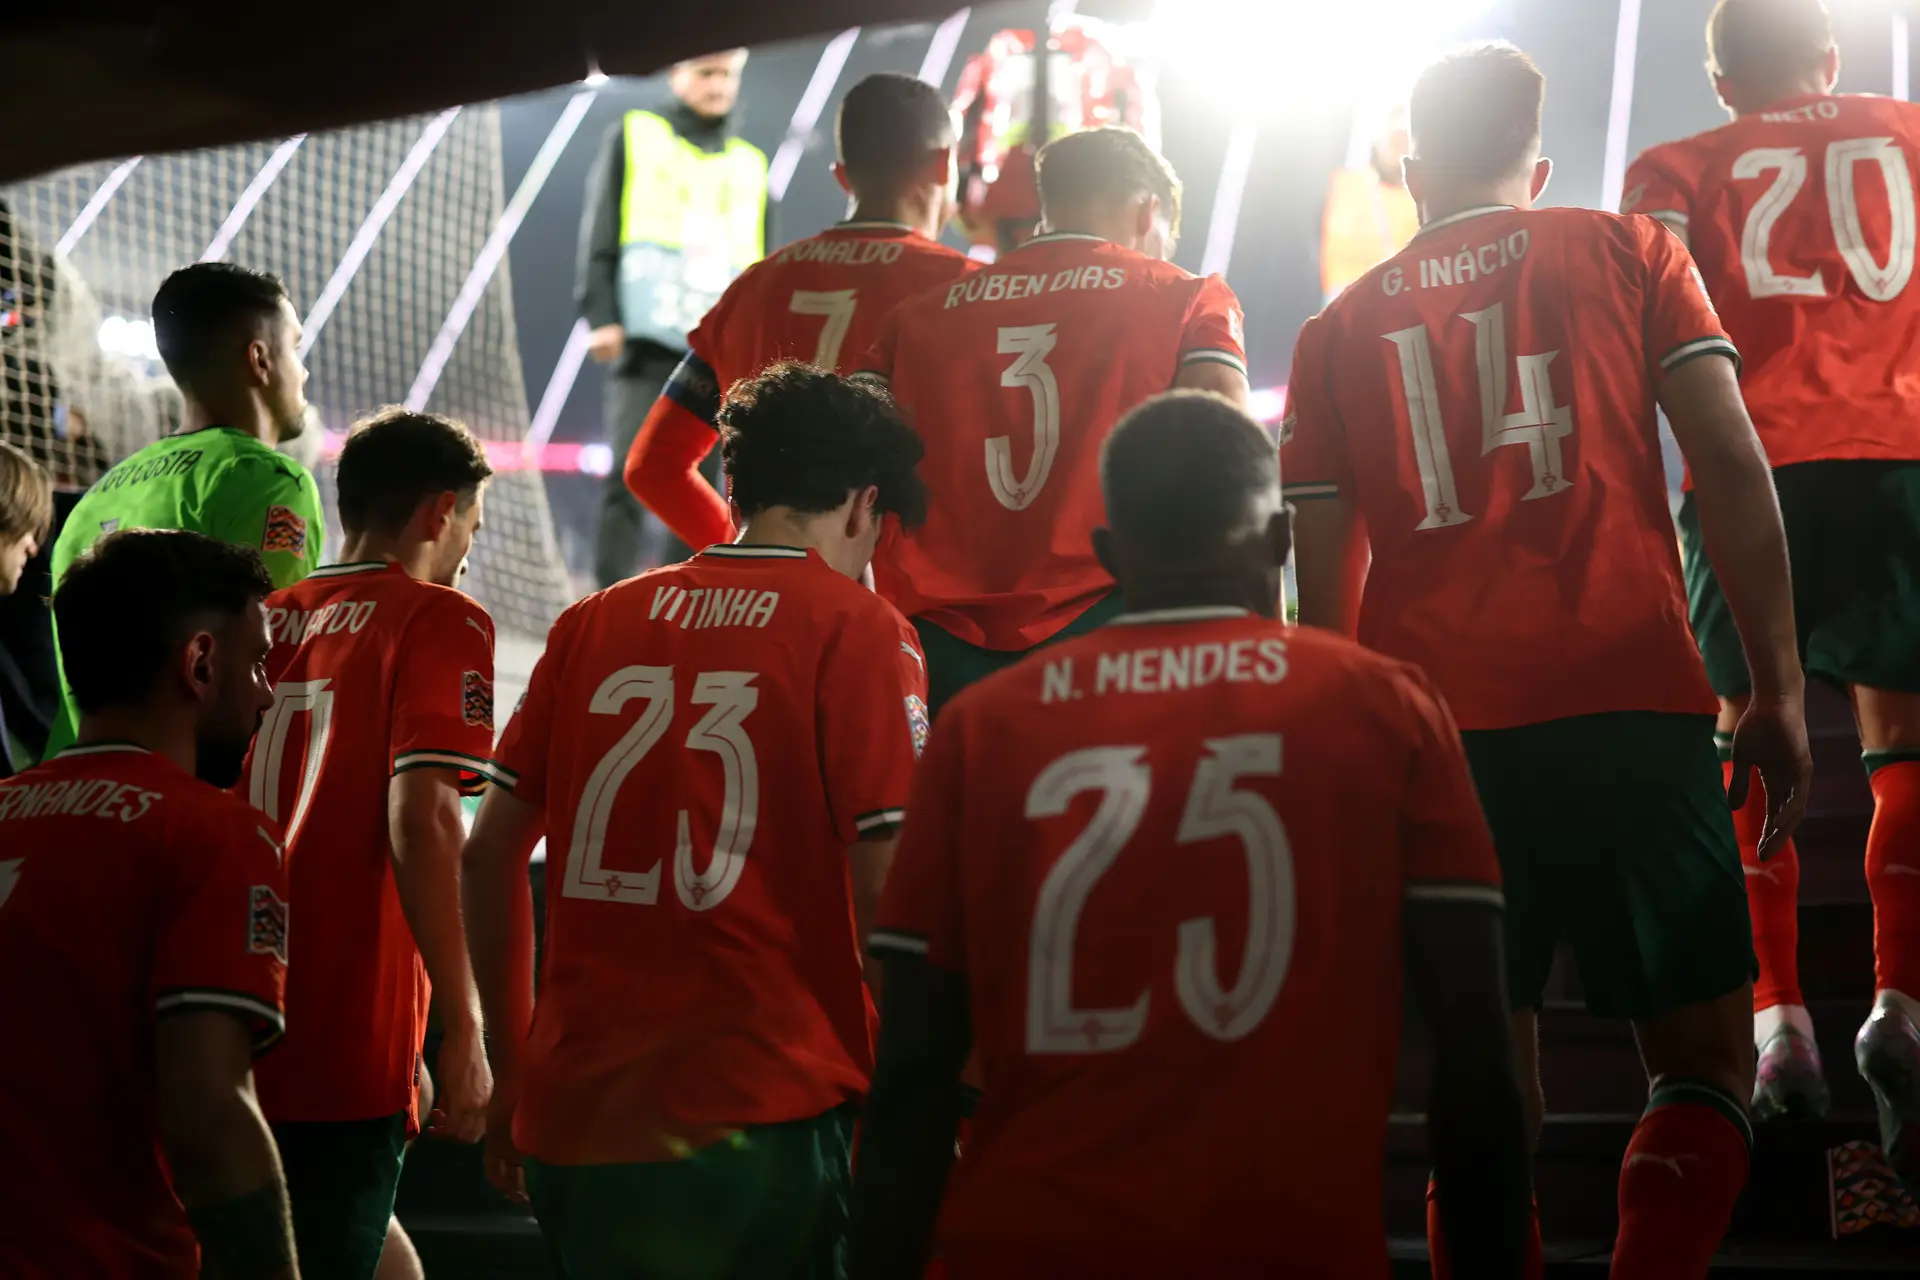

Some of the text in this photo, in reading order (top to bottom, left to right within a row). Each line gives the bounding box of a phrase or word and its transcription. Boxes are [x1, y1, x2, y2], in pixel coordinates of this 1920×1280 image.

[1731, 137, 1916, 302] 20
[1049, 265, 1125, 292] DIAS
[1381, 228, 1530, 297] G. INÁCIO
[788, 288, 858, 374] 7
[984, 322, 1060, 511] 3
[1379, 301, 1575, 531] 14
[268, 600, 378, 645] RNARDO
[648, 585, 780, 630] VITINHA
[1041, 639, 1289, 704] N. MENDES
[0, 779, 164, 824] RNANDES
[561, 664, 761, 912] 23
[1024, 732, 1297, 1055] 25
